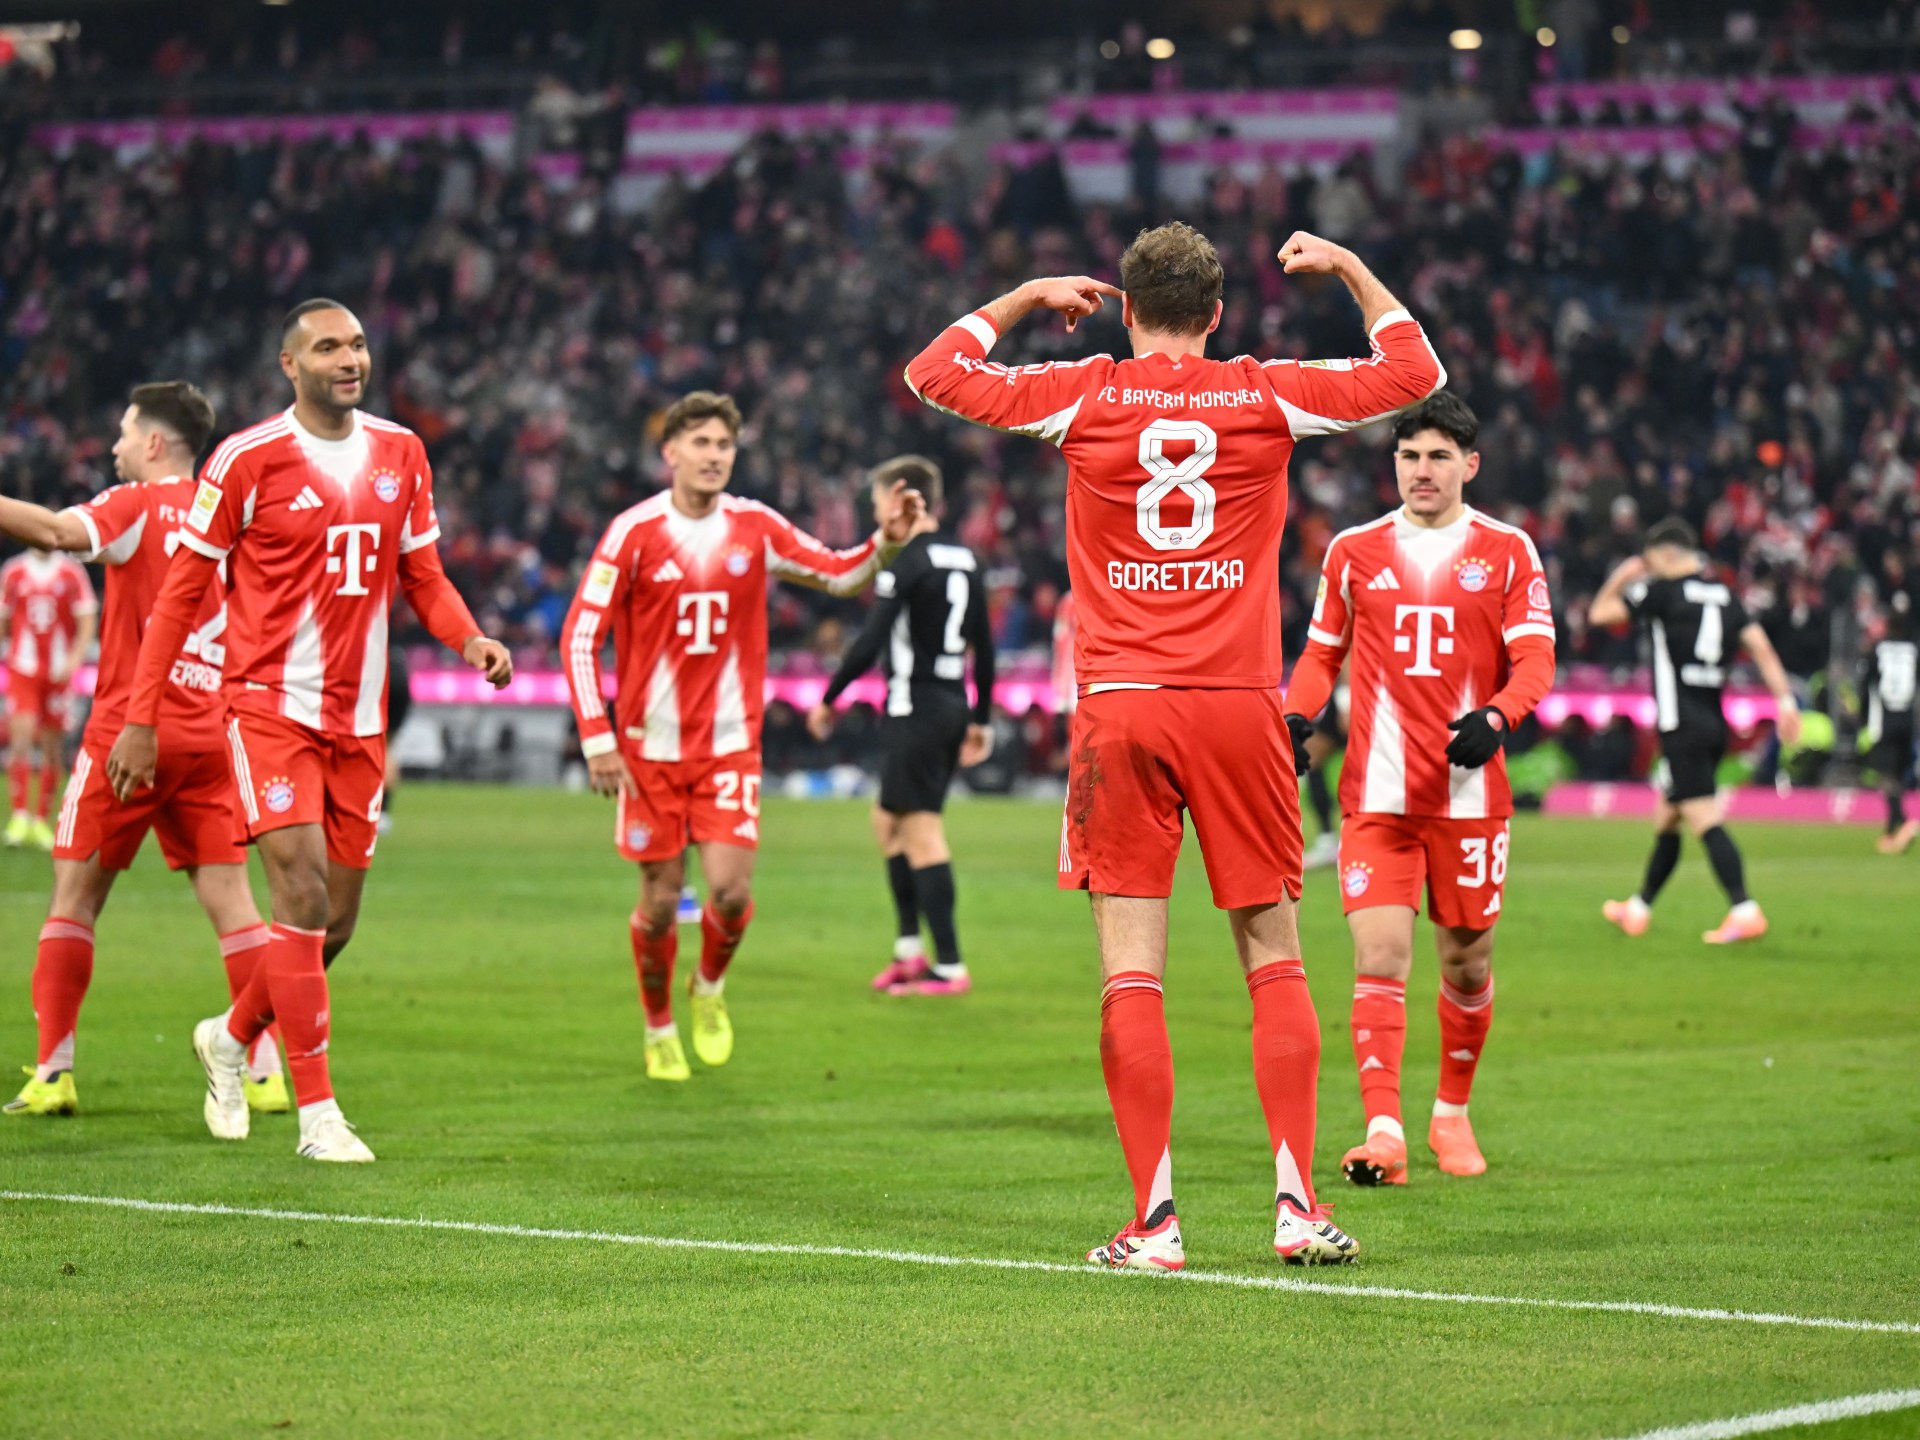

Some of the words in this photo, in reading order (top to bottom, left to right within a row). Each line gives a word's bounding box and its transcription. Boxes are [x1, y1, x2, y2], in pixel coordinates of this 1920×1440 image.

[1097, 386, 1117, 403] FC
[1122, 388, 1184, 409] BAYERN
[1189, 388, 1263, 409] MÜNCHEN
[1137, 419, 1217, 550] 8
[1107, 560, 1244, 591] GORETZKA
[713, 770, 761, 818] 20
[1456, 832, 1508, 888] 38
